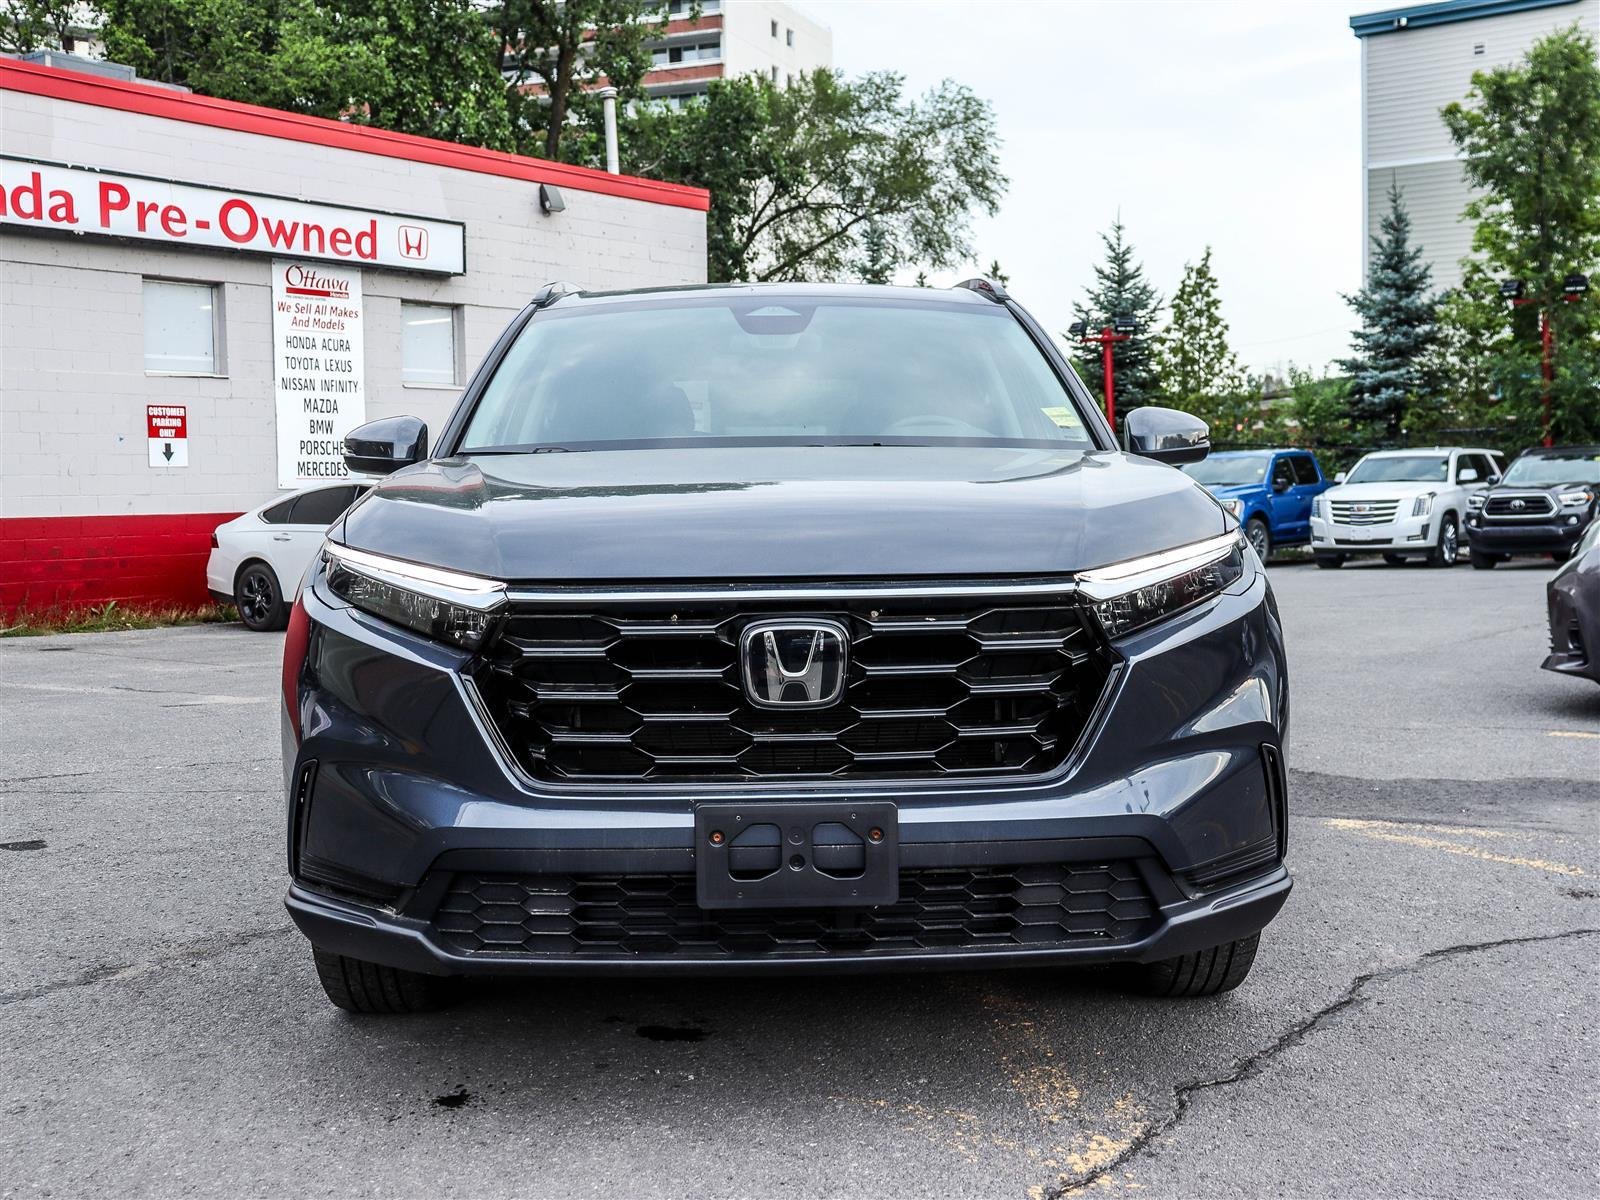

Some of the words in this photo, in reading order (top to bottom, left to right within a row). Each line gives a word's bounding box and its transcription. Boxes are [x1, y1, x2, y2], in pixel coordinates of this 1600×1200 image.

[99, 181, 377, 260] Pre-Owned
[286, 264, 349, 291] Ottawa
[277, 301, 292, 312] We
[294, 302, 312, 314] Sell
[314, 304, 328, 316] All
[329, 305, 359, 319] Makes
[291, 316, 310, 328] And
[312, 318, 345, 331] Models
[285, 335, 317, 350] HONDA
[321, 338, 351, 352] ACURA
[285, 356, 320, 371] TOYOTA
[325, 359, 352, 373] LEXUS
[281, 377, 316, 391] NISSAN
[320, 379, 359, 393] INFINITY
[148, 407, 185, 416] CUSTOMER
[304, 398, 338, 414] MAZDA
[152, 417, 182, 427] PARKING
[310, 420, 333, 435] BMW
[159, 428, 176, 437] ONLY
[300, 440, 344, 456] PORSCHE
[297, 461, 348, 476] MERCEDES
